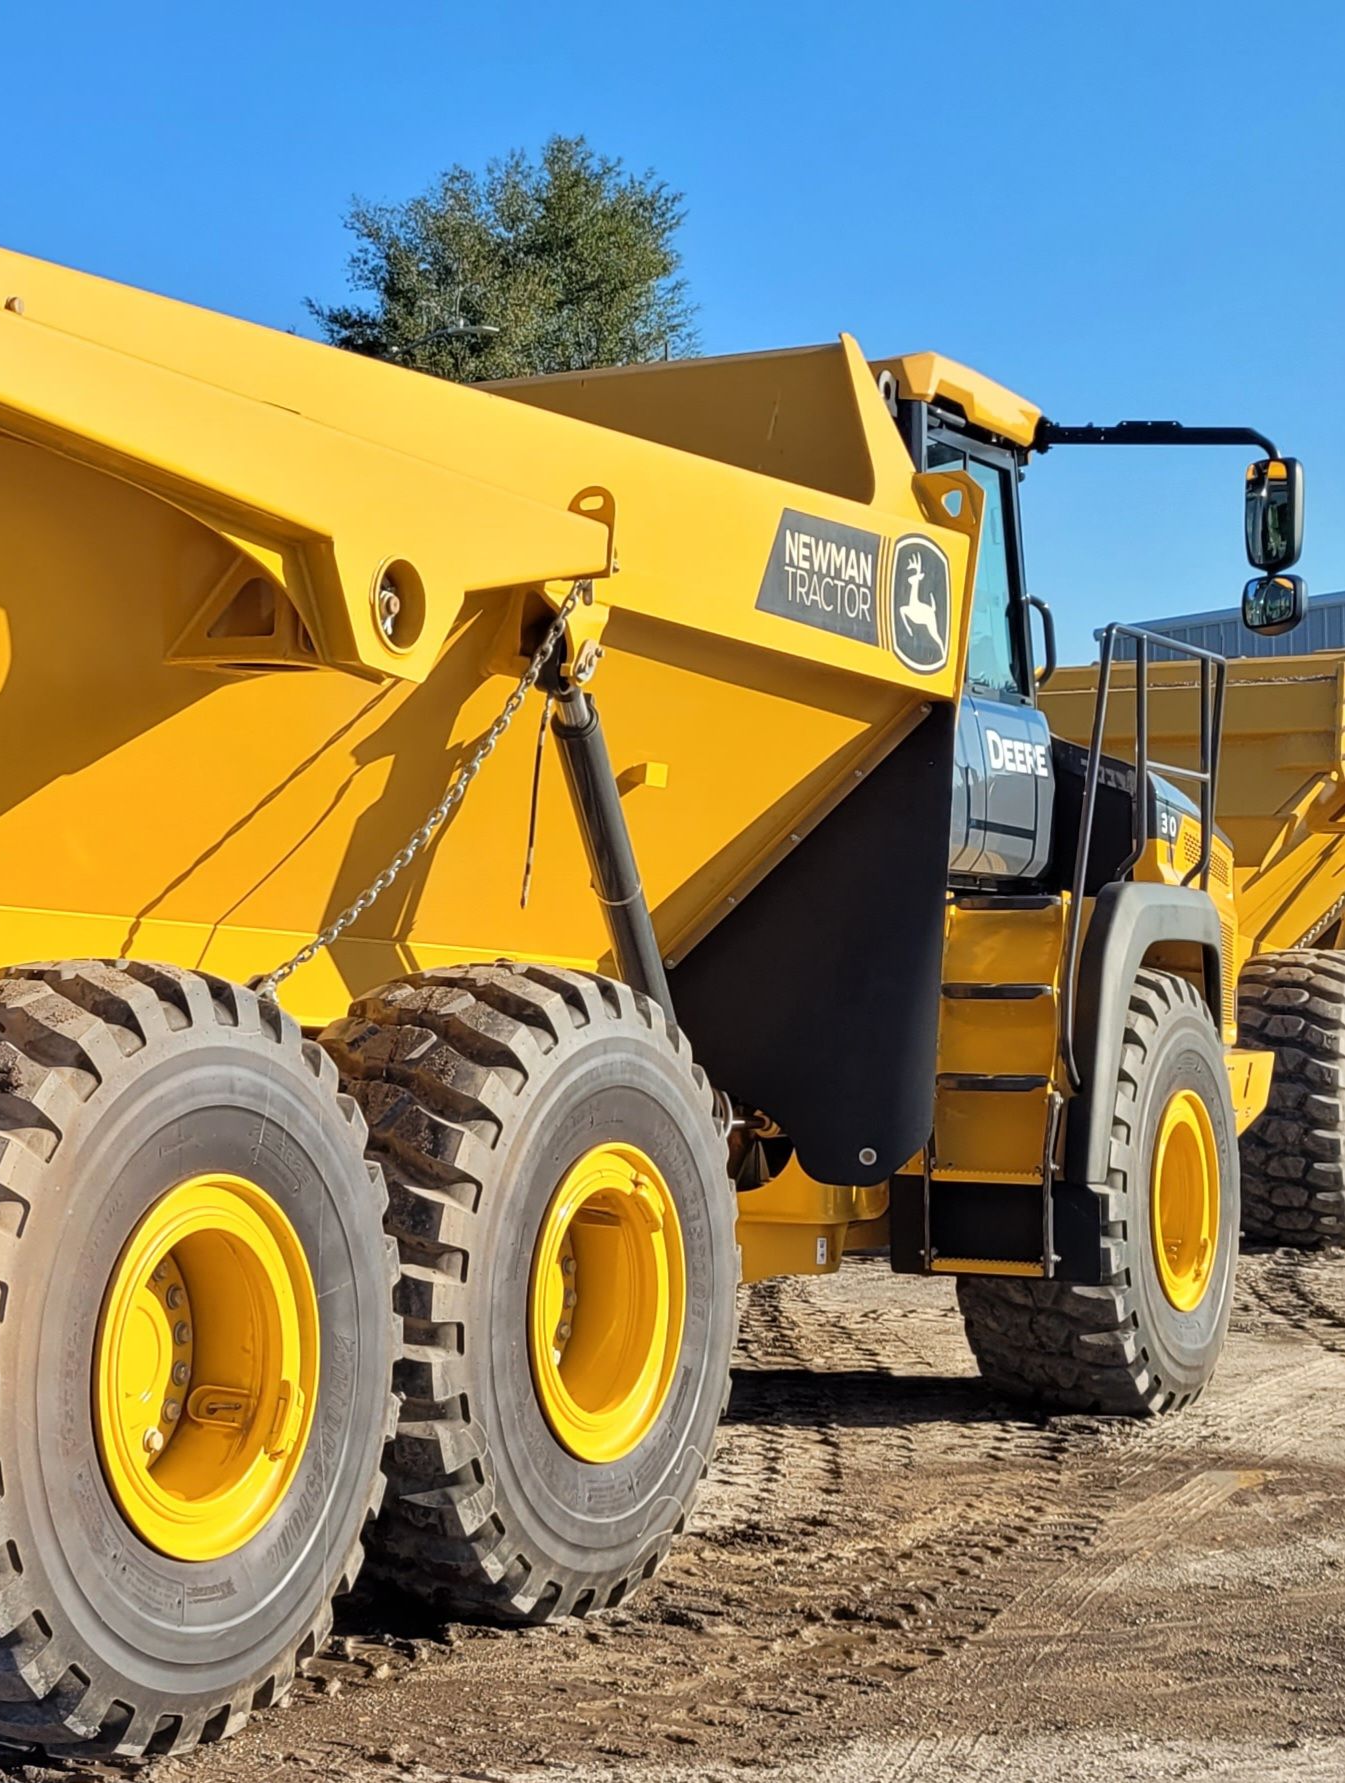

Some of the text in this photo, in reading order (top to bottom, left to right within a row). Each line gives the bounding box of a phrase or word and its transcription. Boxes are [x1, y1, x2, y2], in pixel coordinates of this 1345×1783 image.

[784, 528, 873, 588] NEWMAN
[784, 565, 872, 623] TRACTOR
[985, 728, 1049, 778] DEERE
